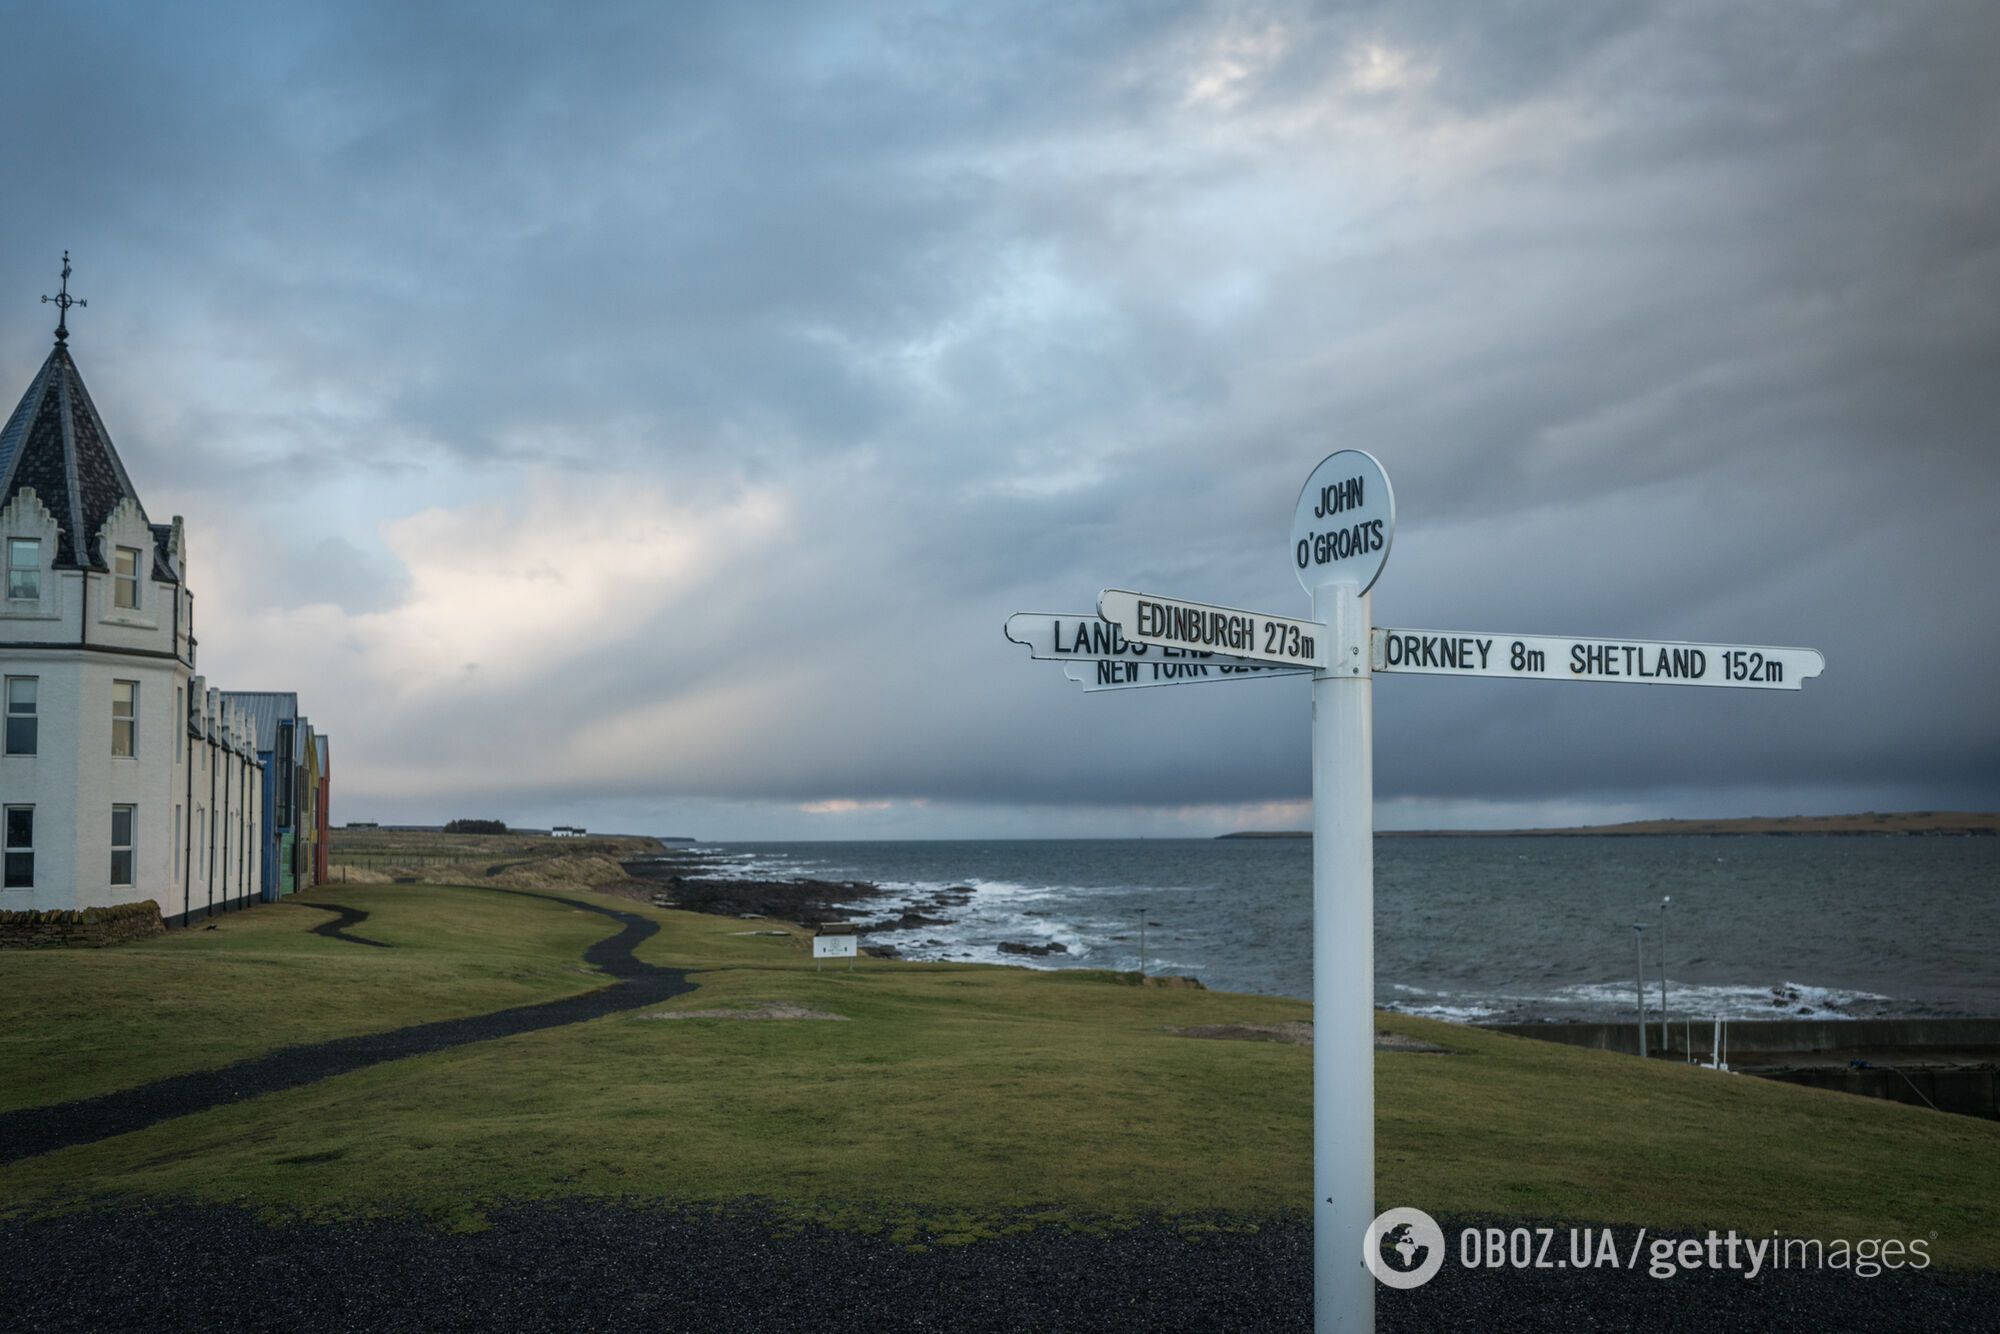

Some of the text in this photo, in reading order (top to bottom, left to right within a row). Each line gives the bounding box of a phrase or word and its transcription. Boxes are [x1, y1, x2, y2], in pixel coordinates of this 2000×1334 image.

[1314, 475, 1364, 519] JOHN
[1296, 519, 1384, 569] O'GROATS
[1137, 600, 1315, 660] EDINBURGH 273m
[1097, 659, 1139, 685] NEW
[1387, 634, 1784, 683] ORKNEY 8m SHETLAND 152m
